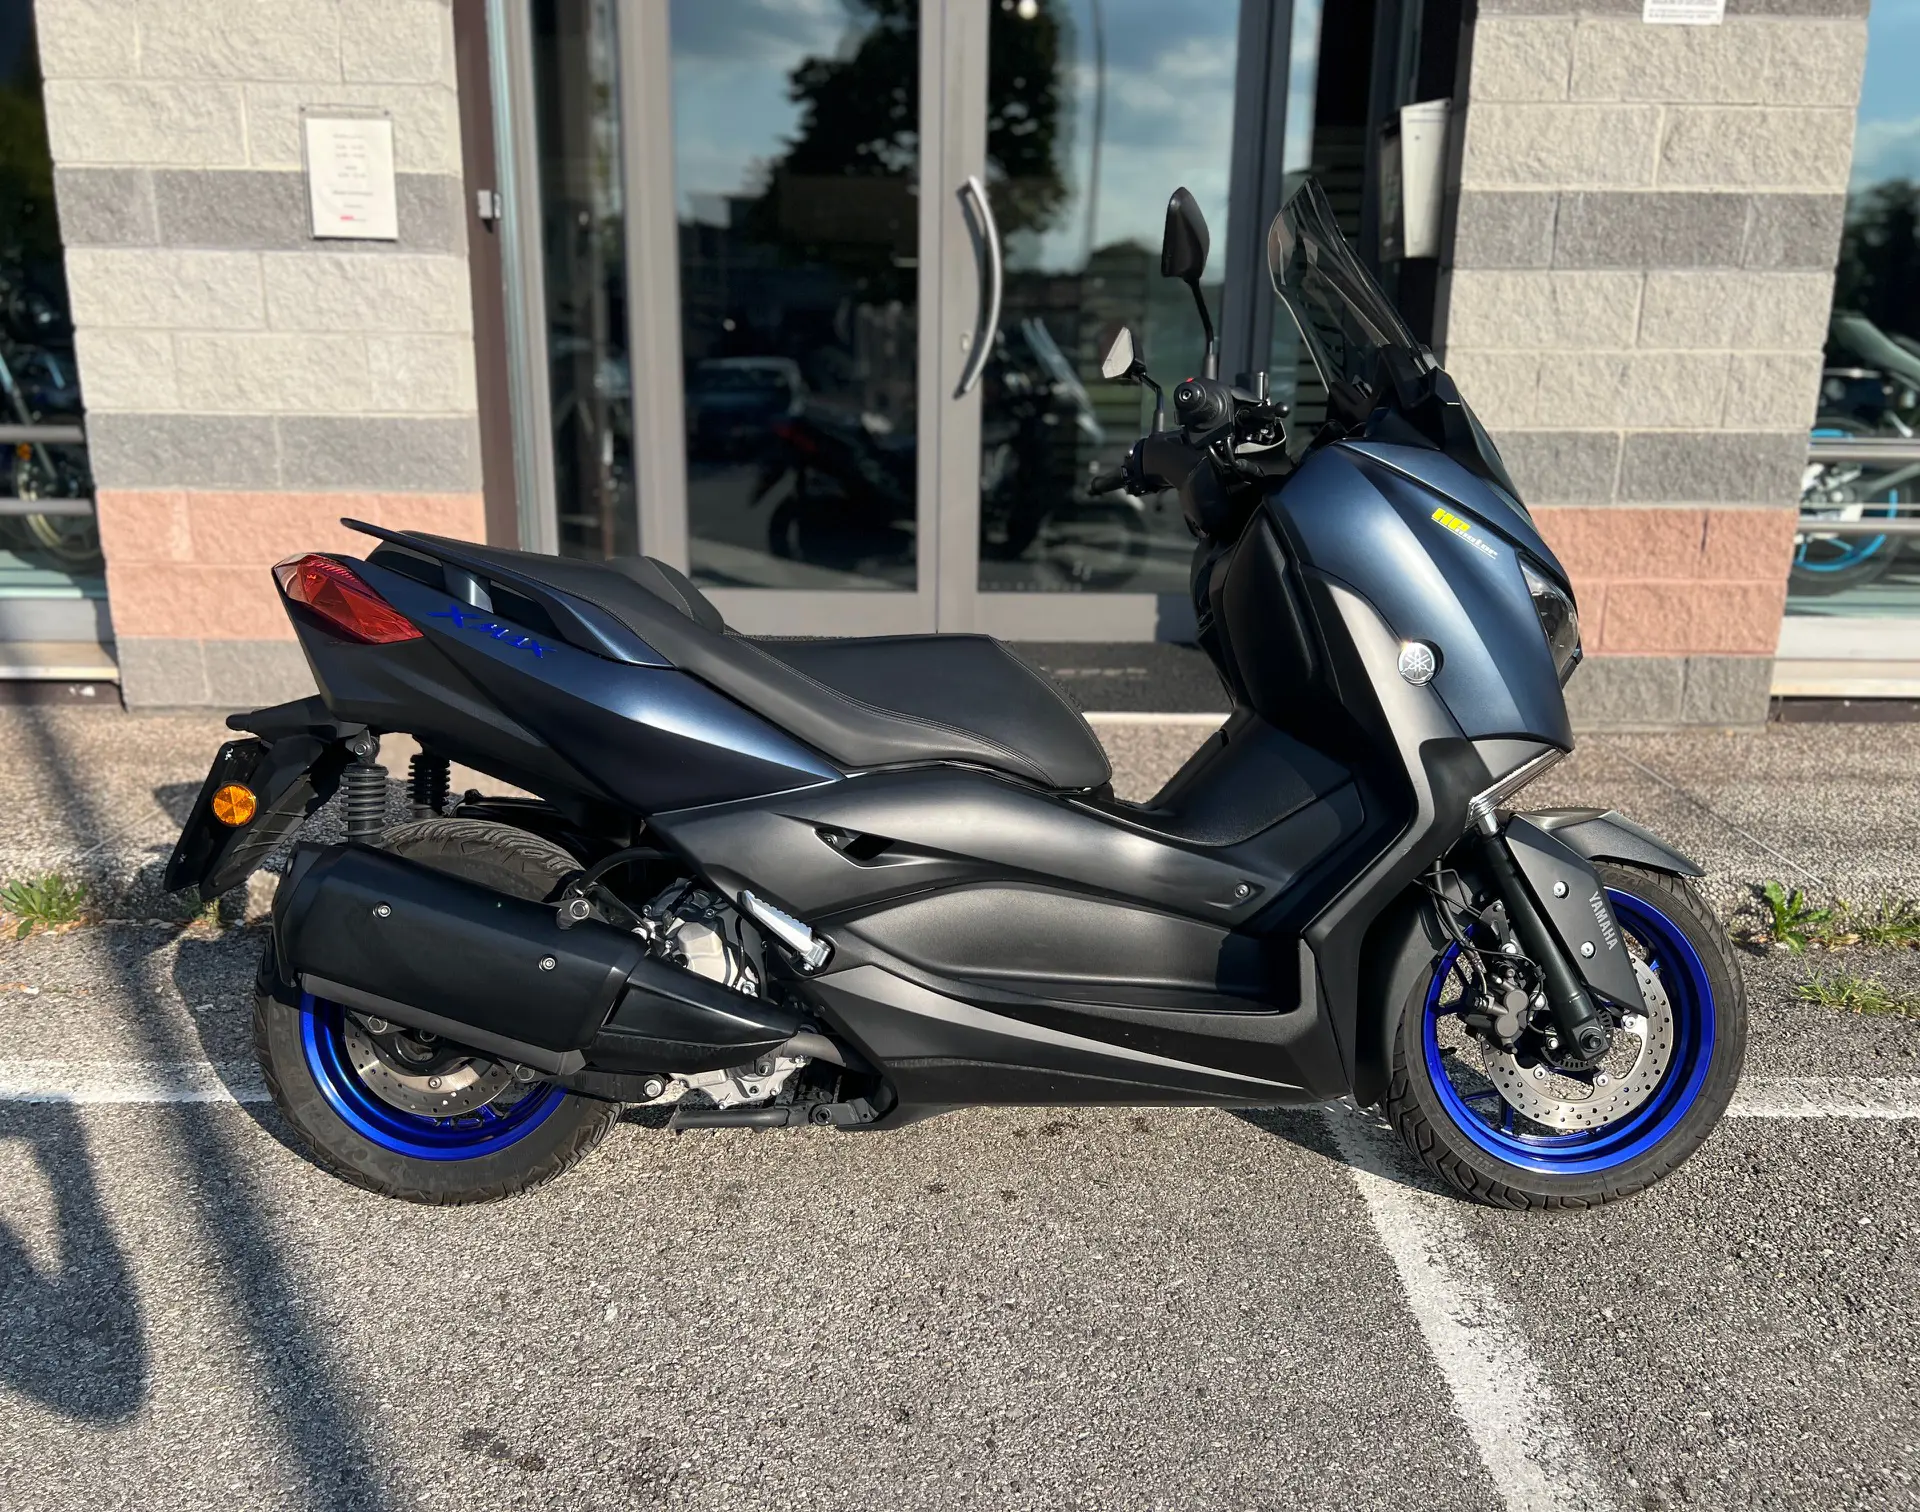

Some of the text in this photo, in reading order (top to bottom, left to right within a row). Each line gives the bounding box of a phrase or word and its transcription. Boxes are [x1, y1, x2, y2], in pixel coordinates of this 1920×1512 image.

[1431, 507, 1498, 556] HP motor
[1588, 890, 1618, 951] YAMAHA
